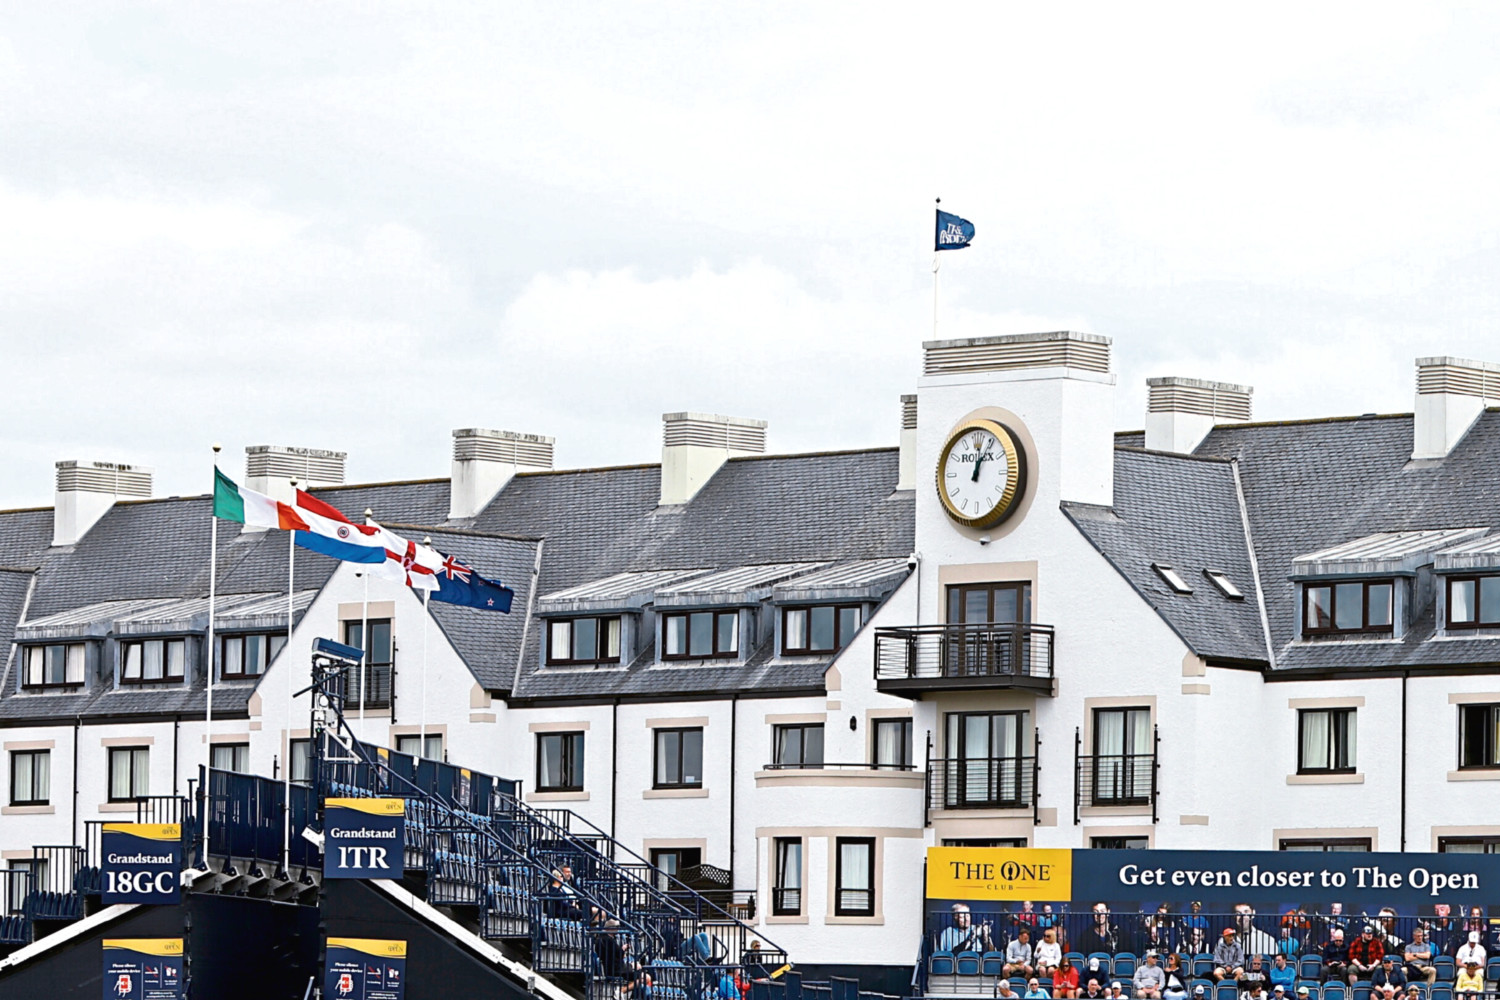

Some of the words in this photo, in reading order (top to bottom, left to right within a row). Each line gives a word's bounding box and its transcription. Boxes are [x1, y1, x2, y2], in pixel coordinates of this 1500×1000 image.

[330, 827, 397, 839] Grandstand
[107, 852, 173, 864] Grandstand
[950, 861, 994, 880] THE
[1119, 864, 1166, 886] Get
[1171, 869, 1232, 887] even
[1237, 865, 1315, 888] closer
[1320, 869, 1347, 888] to
[1352, 866, 1403, 889] The
[1408, 867, 1479, 896] Open
[106, 871, 174, 894] 18GC
